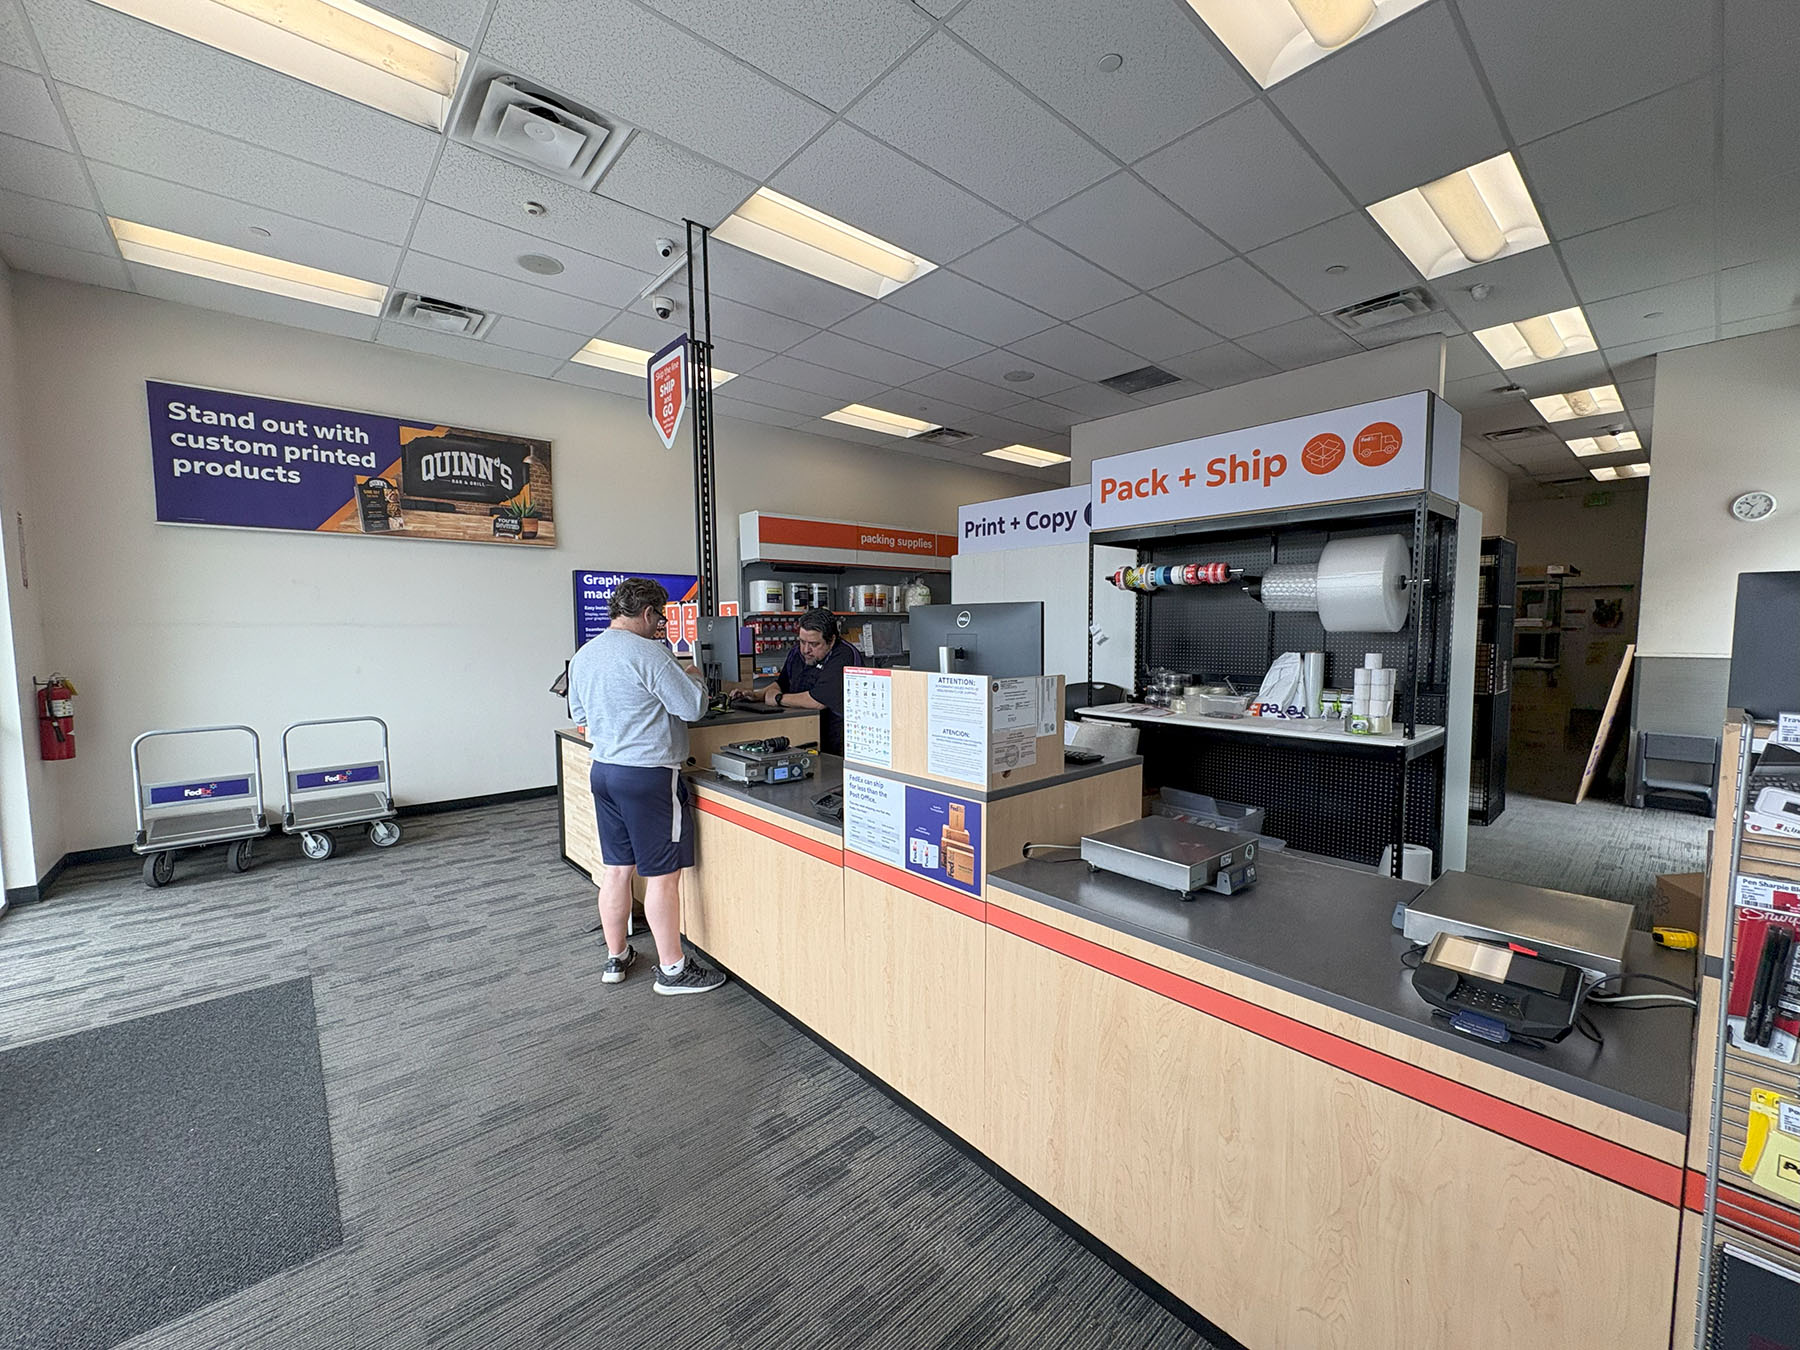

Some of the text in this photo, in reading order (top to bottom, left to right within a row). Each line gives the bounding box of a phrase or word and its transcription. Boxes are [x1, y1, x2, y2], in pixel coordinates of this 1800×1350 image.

[660, 378, 676, 398] SHIP
[664, 393, 672, 403] and
[662, 402, 674, 418] GO
[168, 402, 369, 445] Stand out with
[170, 432, 376, 468] custom printed
[172, 458, 302, 484] products
[420, 450, 513, 490] QUINN'S
[1101, 448, 1288, 504] Pack + Ship
[964, 508, 1078, 539] Print + Copy
[860, 534, 933, 550] packing supplies
[671, 609, 676, 619] 1
[688, 608, 693, 619] 2
[726, 607, 732, 616] 3
[938, 677, 976, 686] ATTENTION:
[324, 774, 348, 782] FedEx
[849, 774, 864, 783] FedEx
[874, 780, 884, 789] ship
[184, 788, 212, 796] FedEx
[850, 790, 877, 804] Post Office.
[857, 784, 866, 792] less
[867, 786, 878, 795] than
[879, 790, 888, 798] the
[1742, 878, 1758, 886] Pen
[1758, 880, 1790, 891] Sharpie
